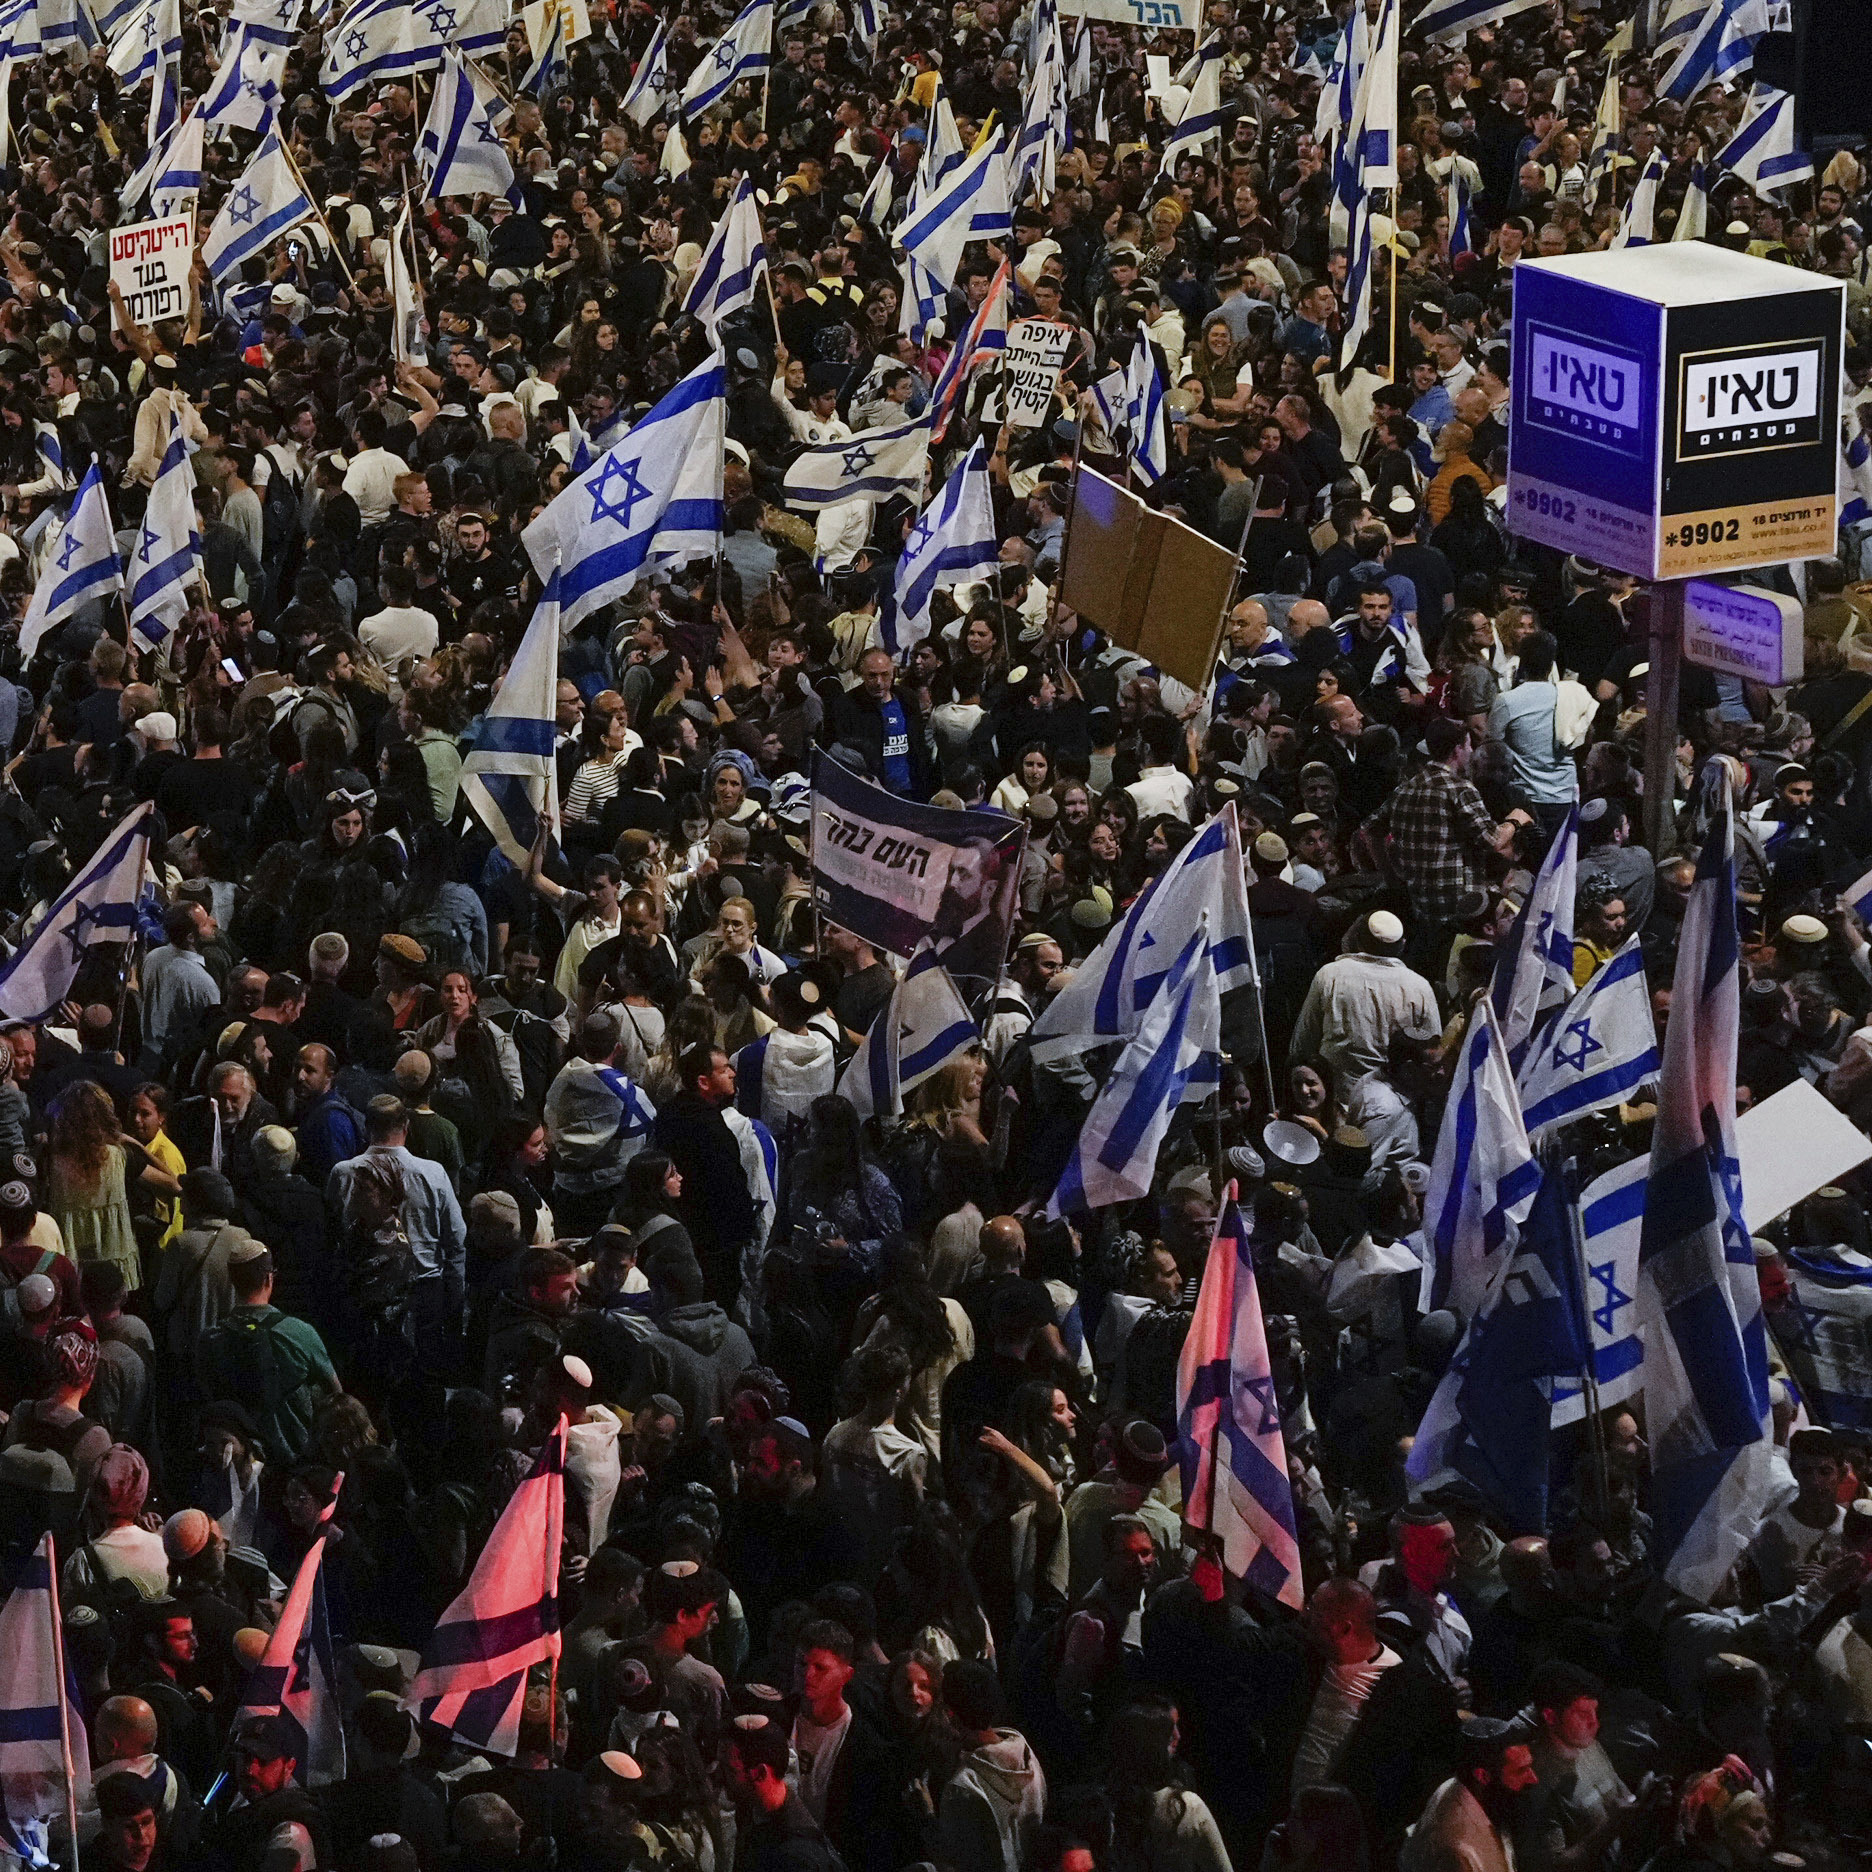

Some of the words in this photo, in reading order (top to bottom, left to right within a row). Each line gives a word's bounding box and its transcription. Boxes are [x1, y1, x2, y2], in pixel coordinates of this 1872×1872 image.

[112, 222, 188, 261] הייטקיסט
[133, 260, 168, 288] בעד
[1021, 324, 1065, 346] איפה
[1015, 369, 1054, 392] בגוש
[1011, 386, 1050, 415] קטיף
[1544, 405, 1623, 439] מטבחים
[1700, 422, 1796, 446] מטבחים
[1769, 510, 1812, 524] חרוצים
[1814, 507, 1827, 518] יד
[826, 811, 875, 855] בחר
[871, 835, 932, 878] העם
